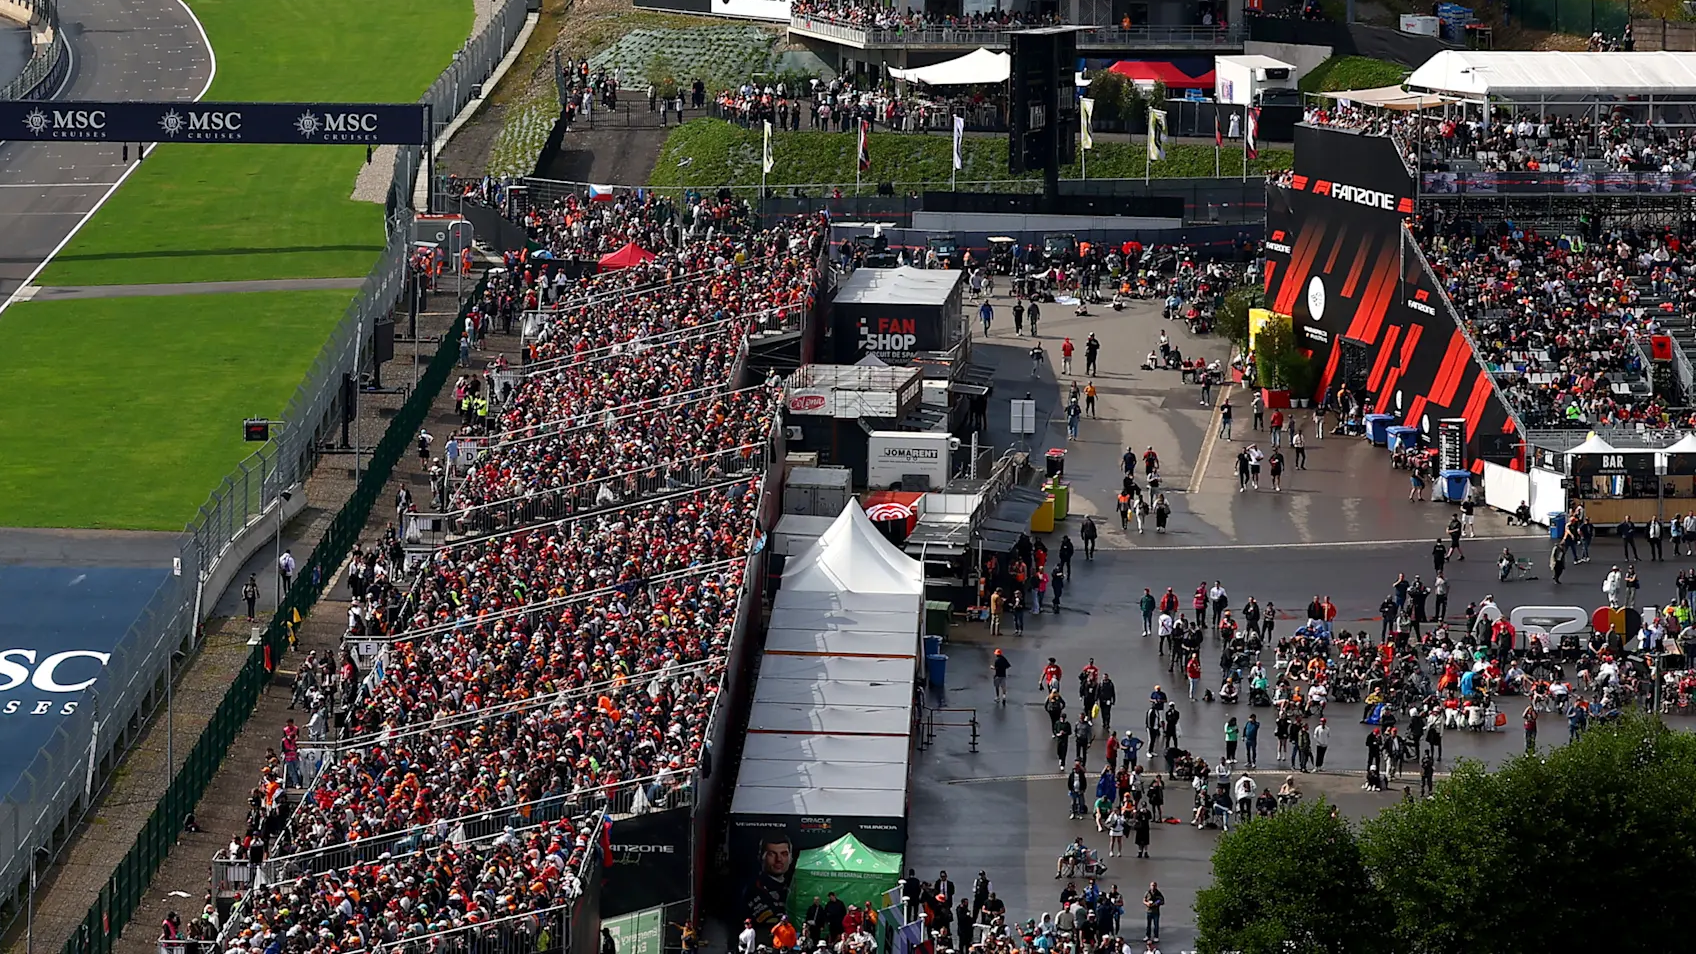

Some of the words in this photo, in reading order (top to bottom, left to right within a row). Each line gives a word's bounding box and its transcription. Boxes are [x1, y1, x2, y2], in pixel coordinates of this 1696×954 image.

[52, 110, 106, 129] MSC
[188, 111, 242, 130] MSC
[324, 113, 378, 132] MSC
[187, 132, 242, 140] CRUISES
[323, 133, 378, 141] CRUISES
[1332, 182, 1395, 211] FANZONE
[1265, 241, 1292, 254] FANZONE
[1407, 299, 1436, 316] FANZONE
[878, 317, 916, 334] FAN
[865, 333, 916, 350] SHOP
[885, 449, 938, 458] JOMARENT
[1603, 455, 1624, 469] BAR
[609, 844, 674, 853] ANZONE
